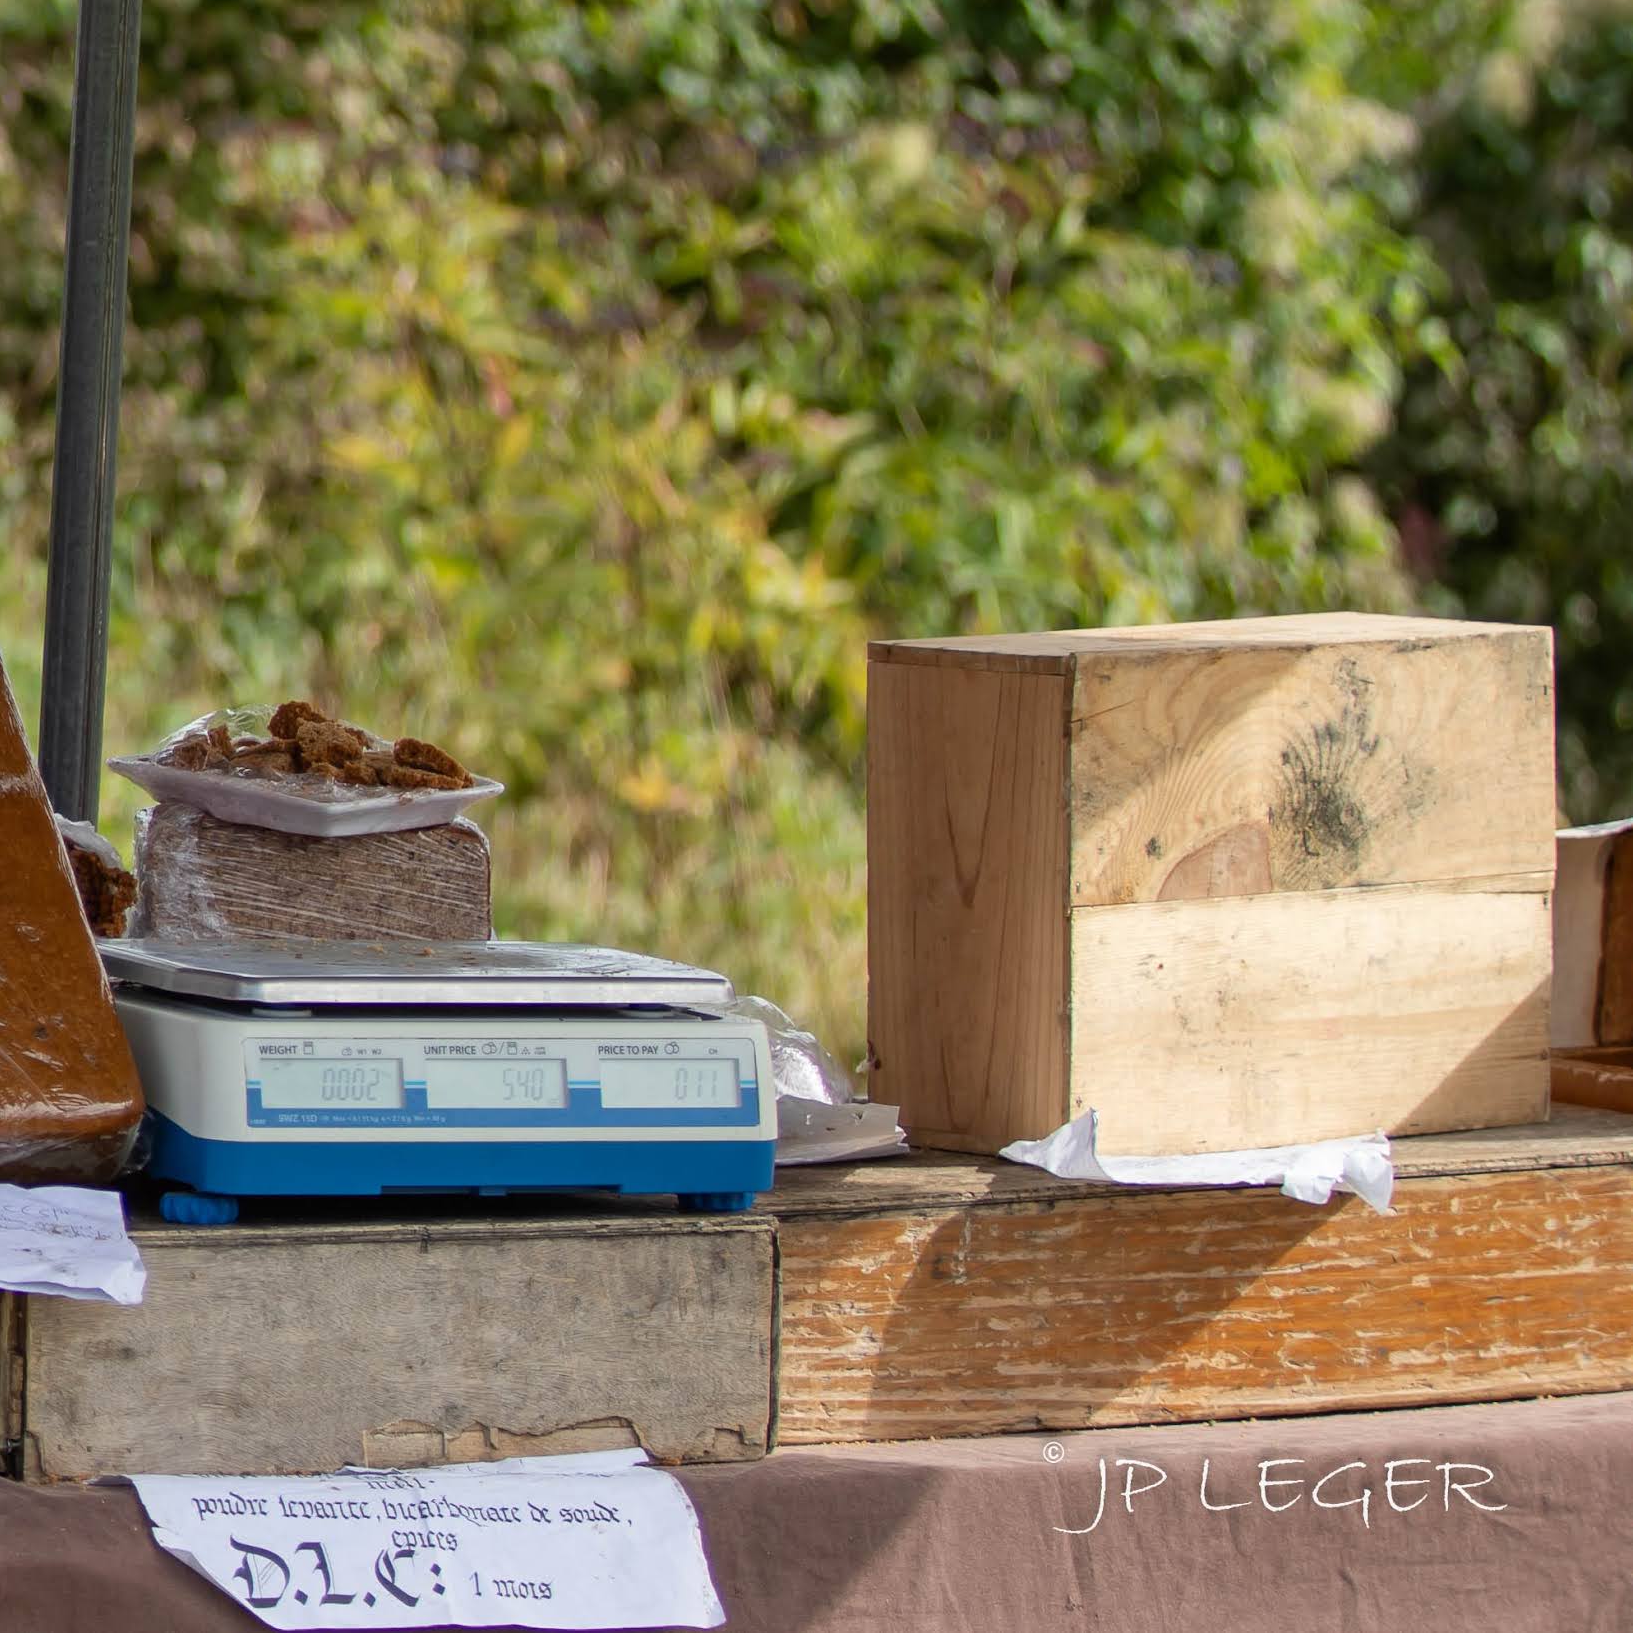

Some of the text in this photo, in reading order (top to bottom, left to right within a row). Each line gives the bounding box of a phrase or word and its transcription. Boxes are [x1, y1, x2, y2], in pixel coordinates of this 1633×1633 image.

[259, 1045, 298, 1055] WEIGHT
[424, 1045, 476, 1055] UNIT PRICE
[598, 1045, 659, 1055] PRICE TO PAY
[192, 1491, 269, 1521] poudre
[382, 1495, 522, 1527] bicarbonate
[528, 1501, 552, 1524] de
[559, 1501, 633, 1526] soude,
[469, 1572, 483, 1597] 1
[493, 1577, 553, 1600] mois
